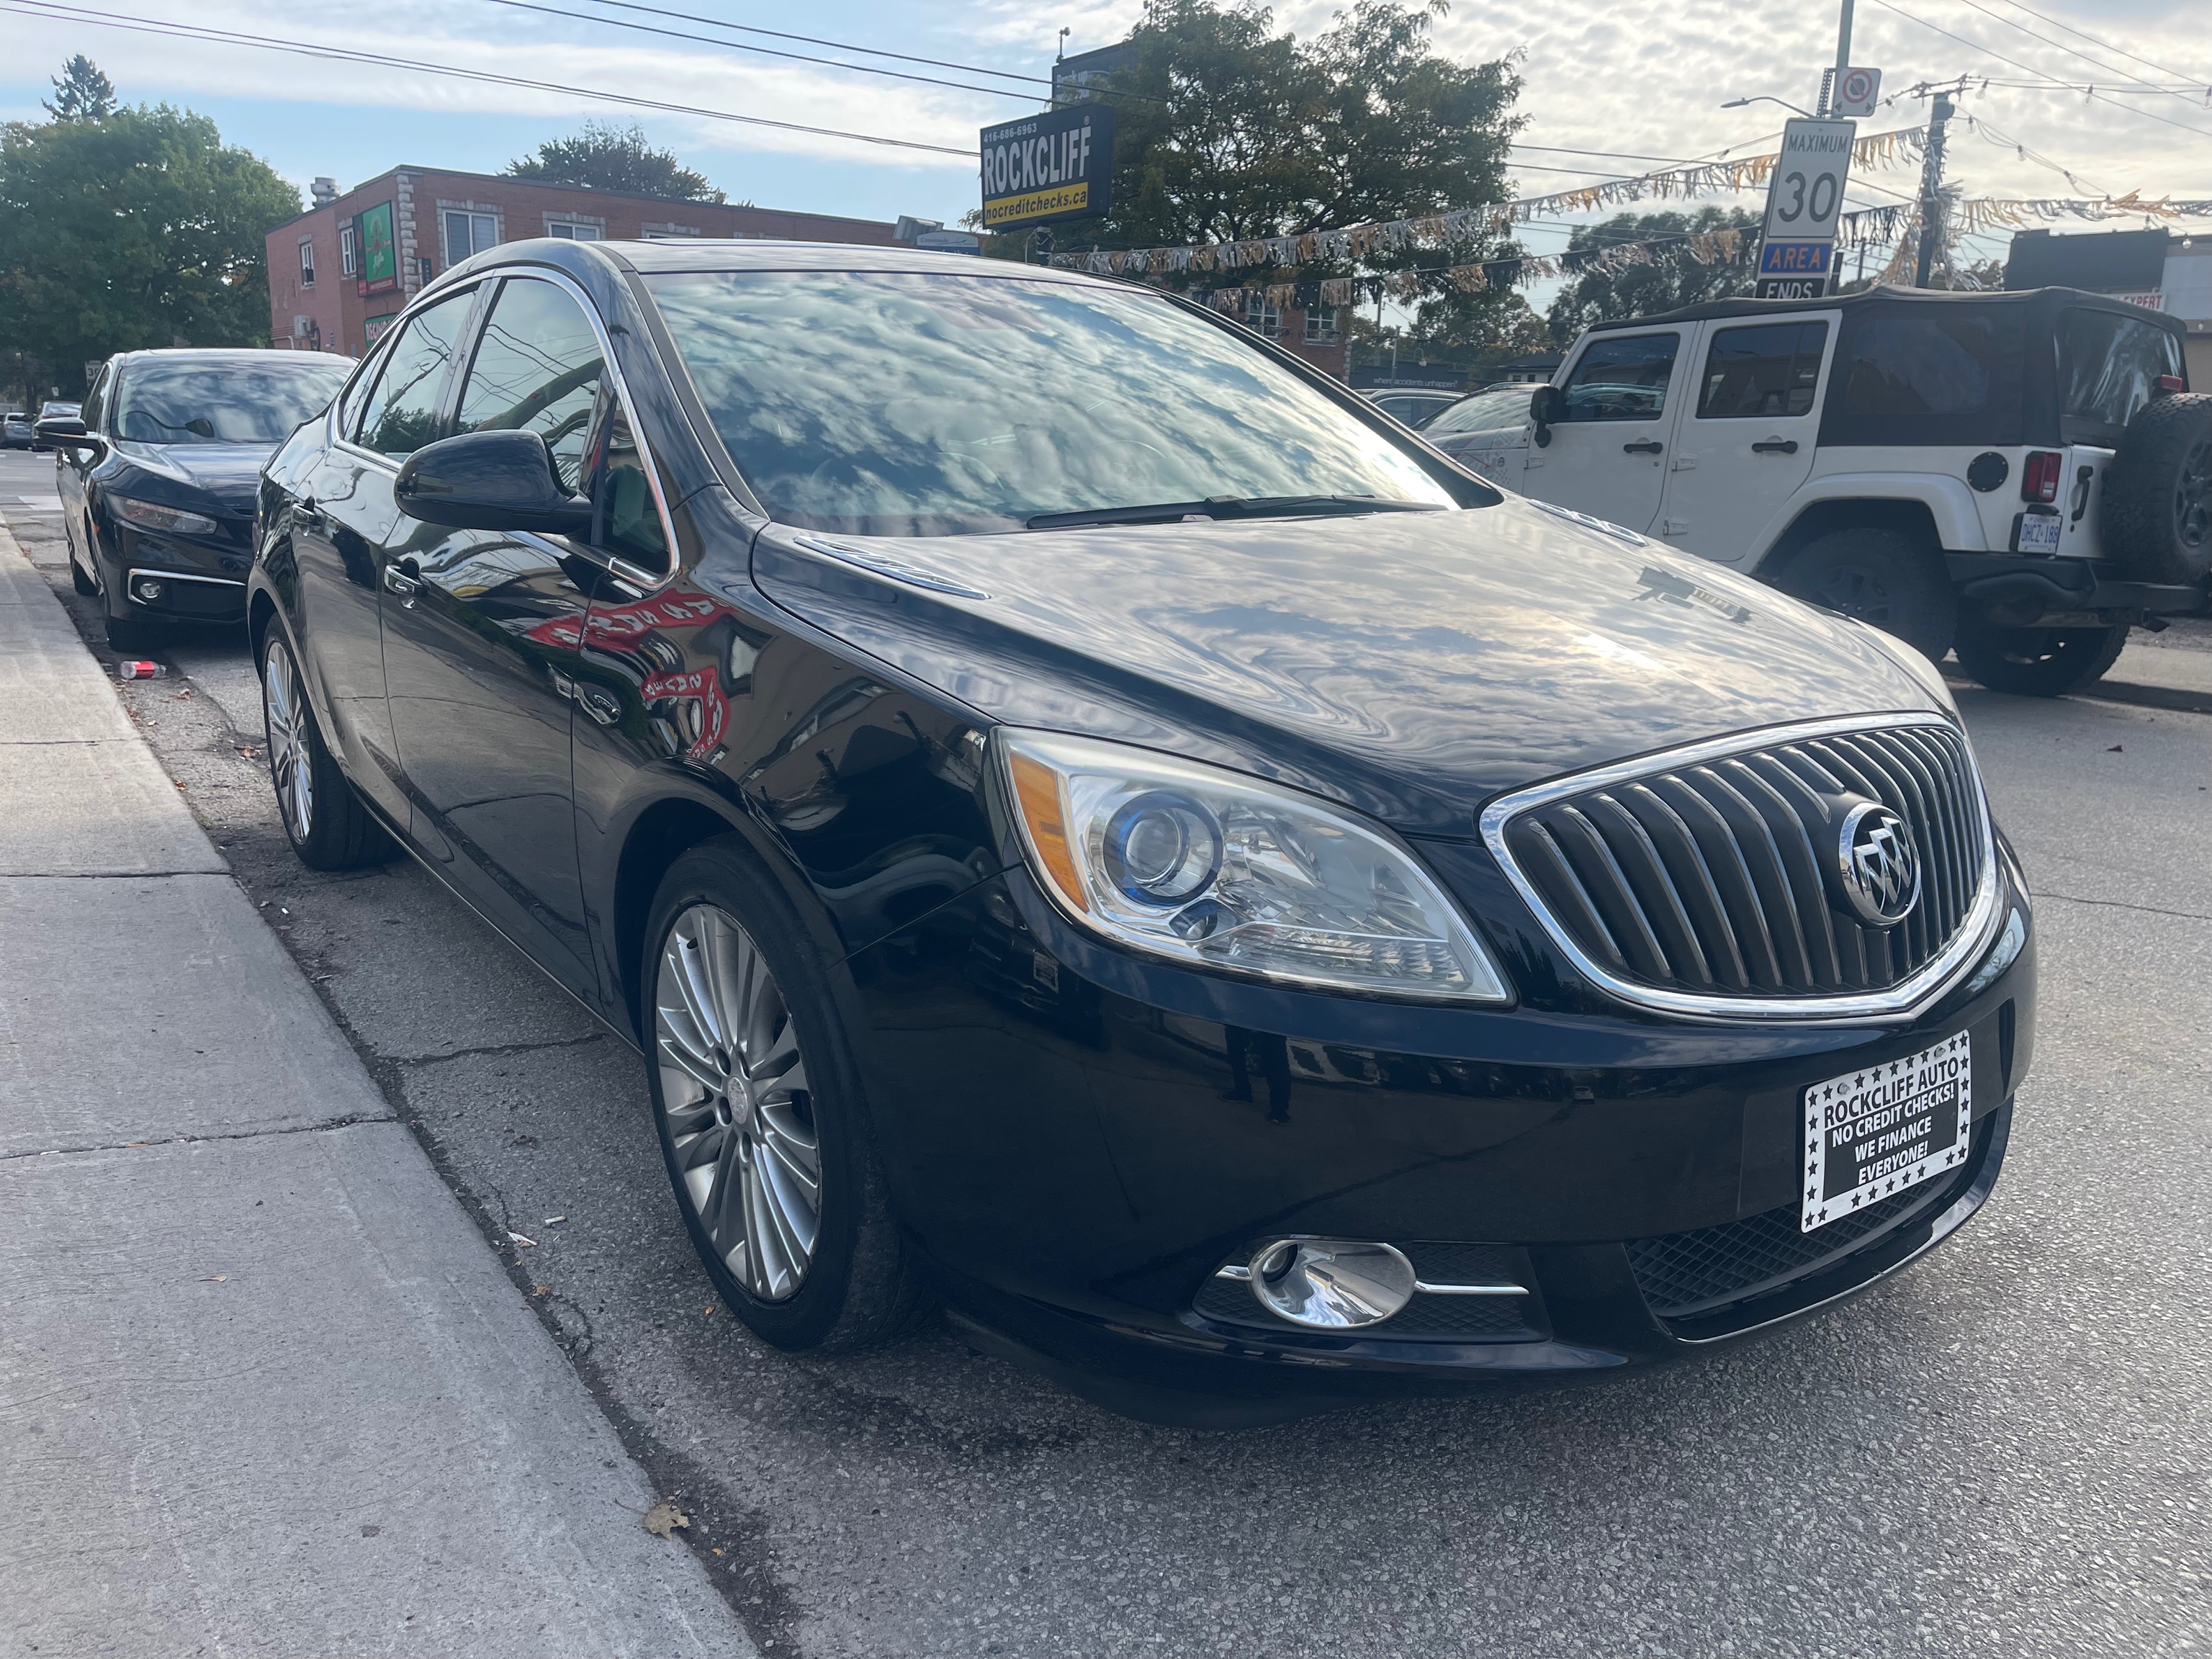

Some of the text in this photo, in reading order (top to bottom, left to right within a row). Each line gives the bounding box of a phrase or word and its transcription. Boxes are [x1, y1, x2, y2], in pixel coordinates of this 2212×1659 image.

[984, 122, 1038, 143] 416-686-6963
[1788, 135, 1848, 153] MAXIMUM
[984, 126, 1092, 196] ROCKCLIFF
[986, 190, 1087, 220] nocreditchecks.ca
[1778, 171, 1837, 222] 30
[1768, 247, 1822, 269] AREA
[1766, 282, 1815, 299] ENDS
[1824, 1057, 1959, 1128] ROCKCLIFF AUTO
[1832, 1082, 1955, 1148] NO CREDIT CHECKS!
[1855, 1116, 1932, 1163] WE FINANCE
[1858, 1140, 1929, 1185] EVERYONE!
